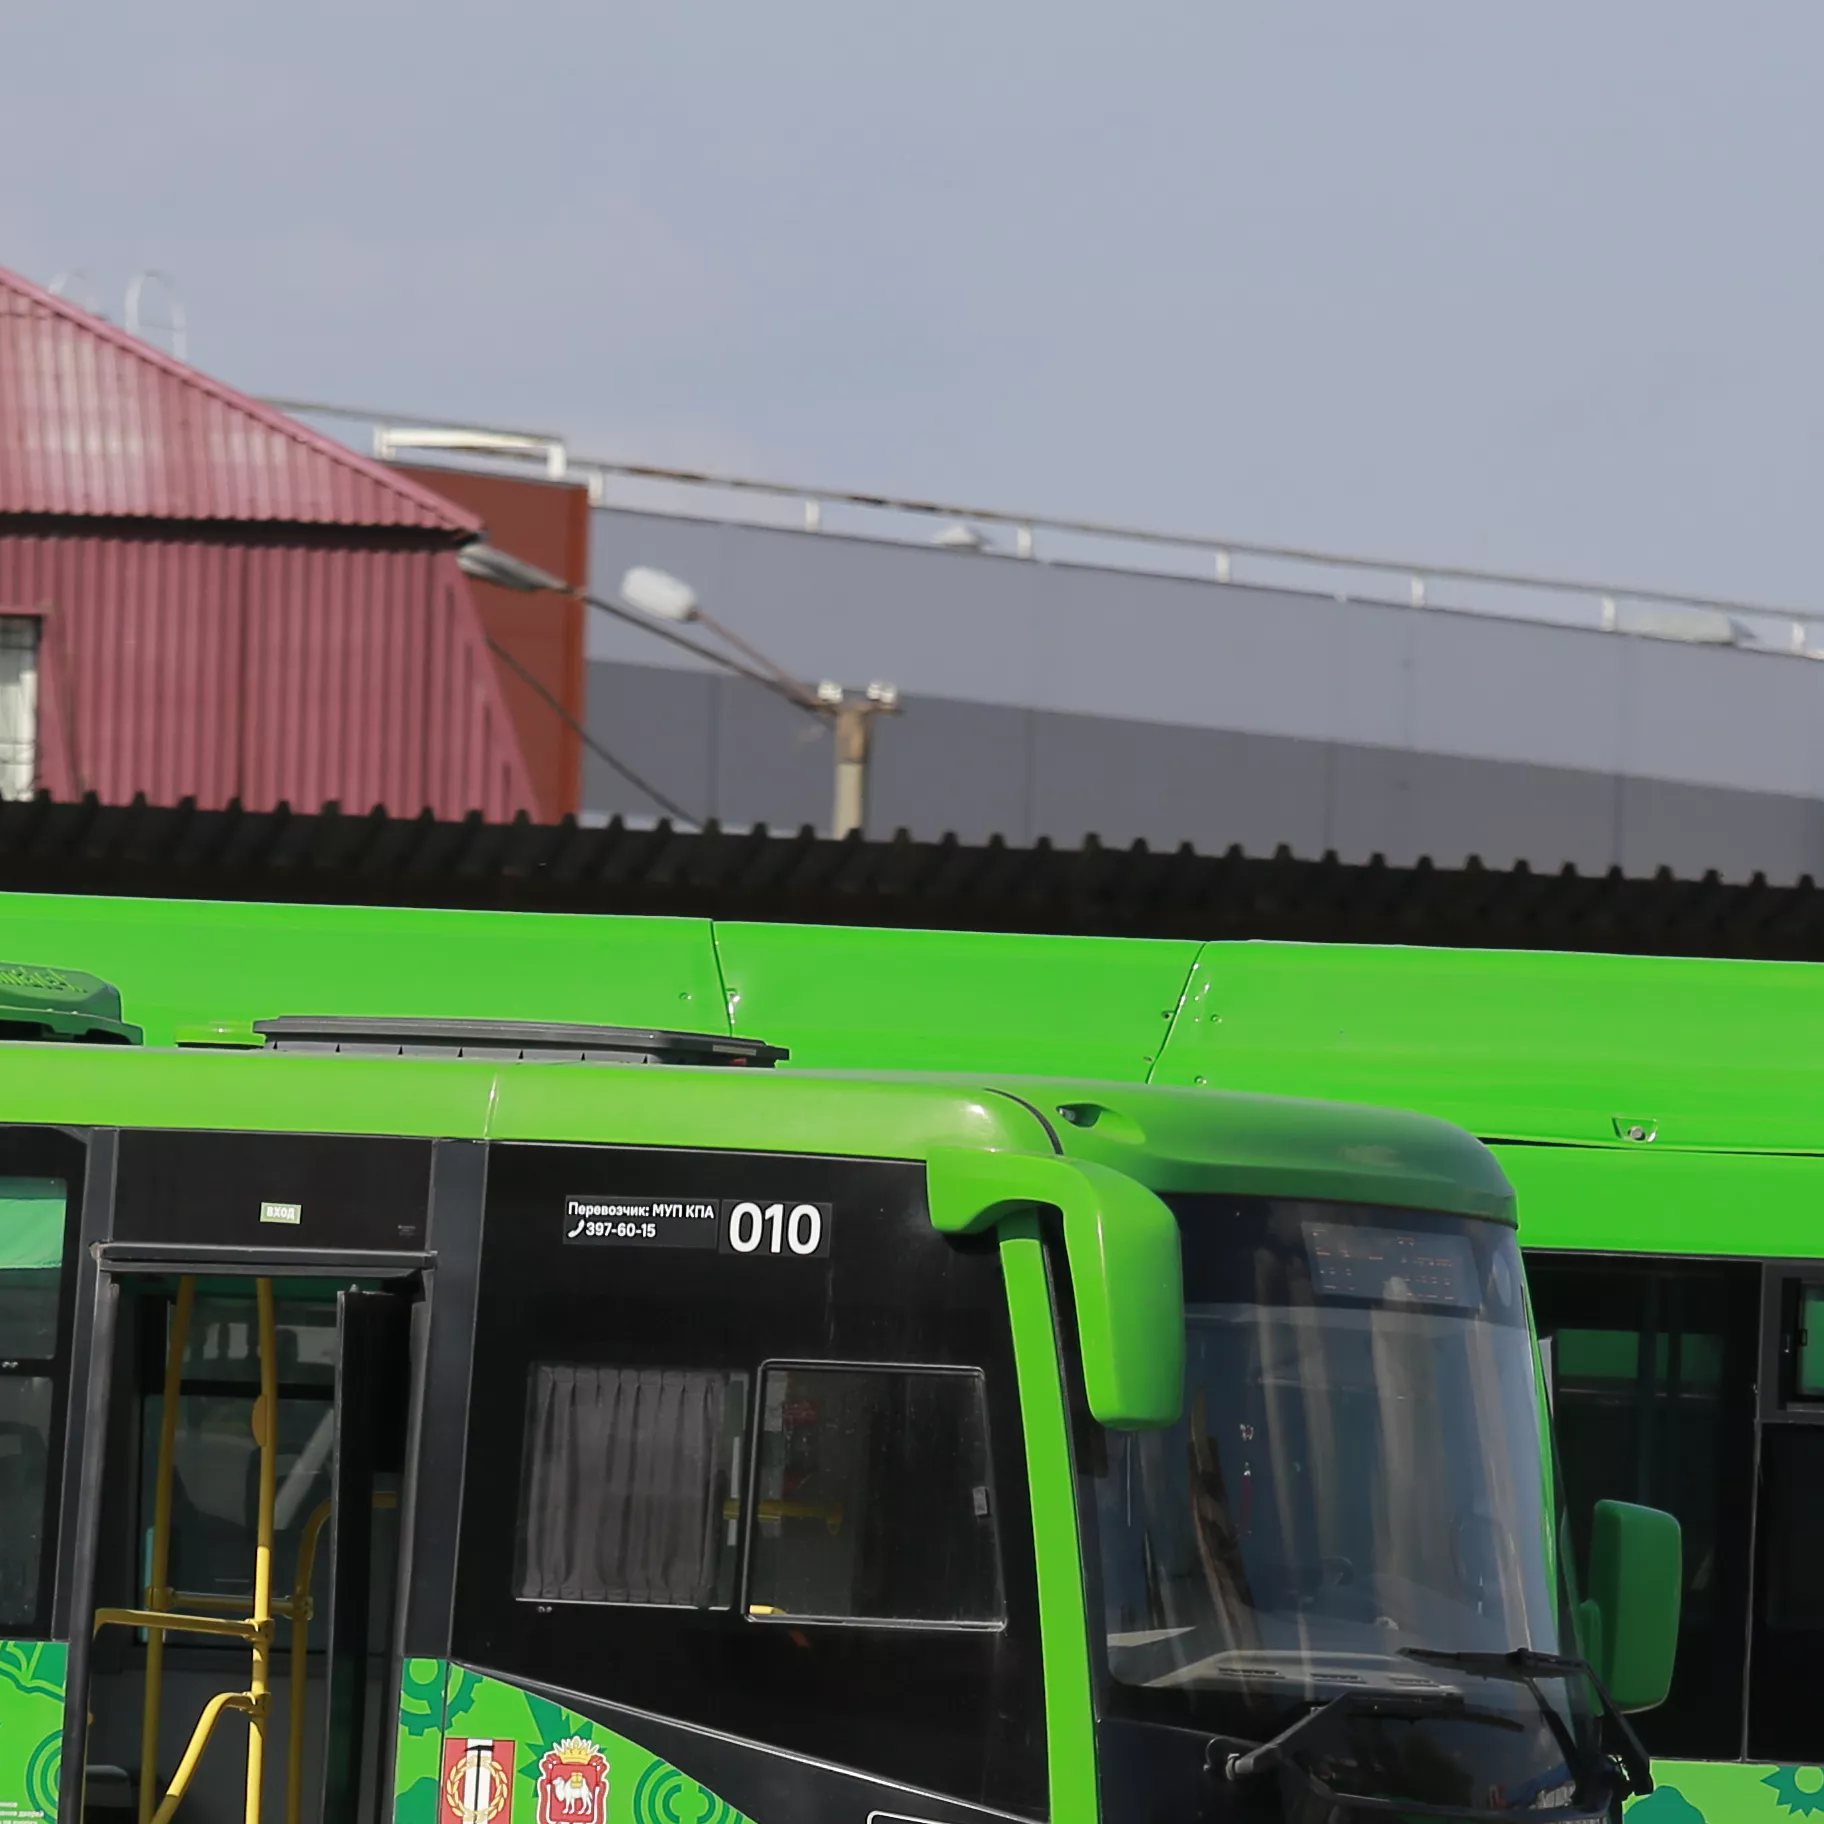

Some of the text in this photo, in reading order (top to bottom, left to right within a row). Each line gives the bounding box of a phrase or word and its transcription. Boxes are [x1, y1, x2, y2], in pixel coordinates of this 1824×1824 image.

[266, 1206, 295, 1221] ВХОД
[568, 1202, 715, 1219] Перевозчик: МУП КПА
[585, 1222, 656, 1238] 397-60-15
[729, 1202, 822, 1255] 010
